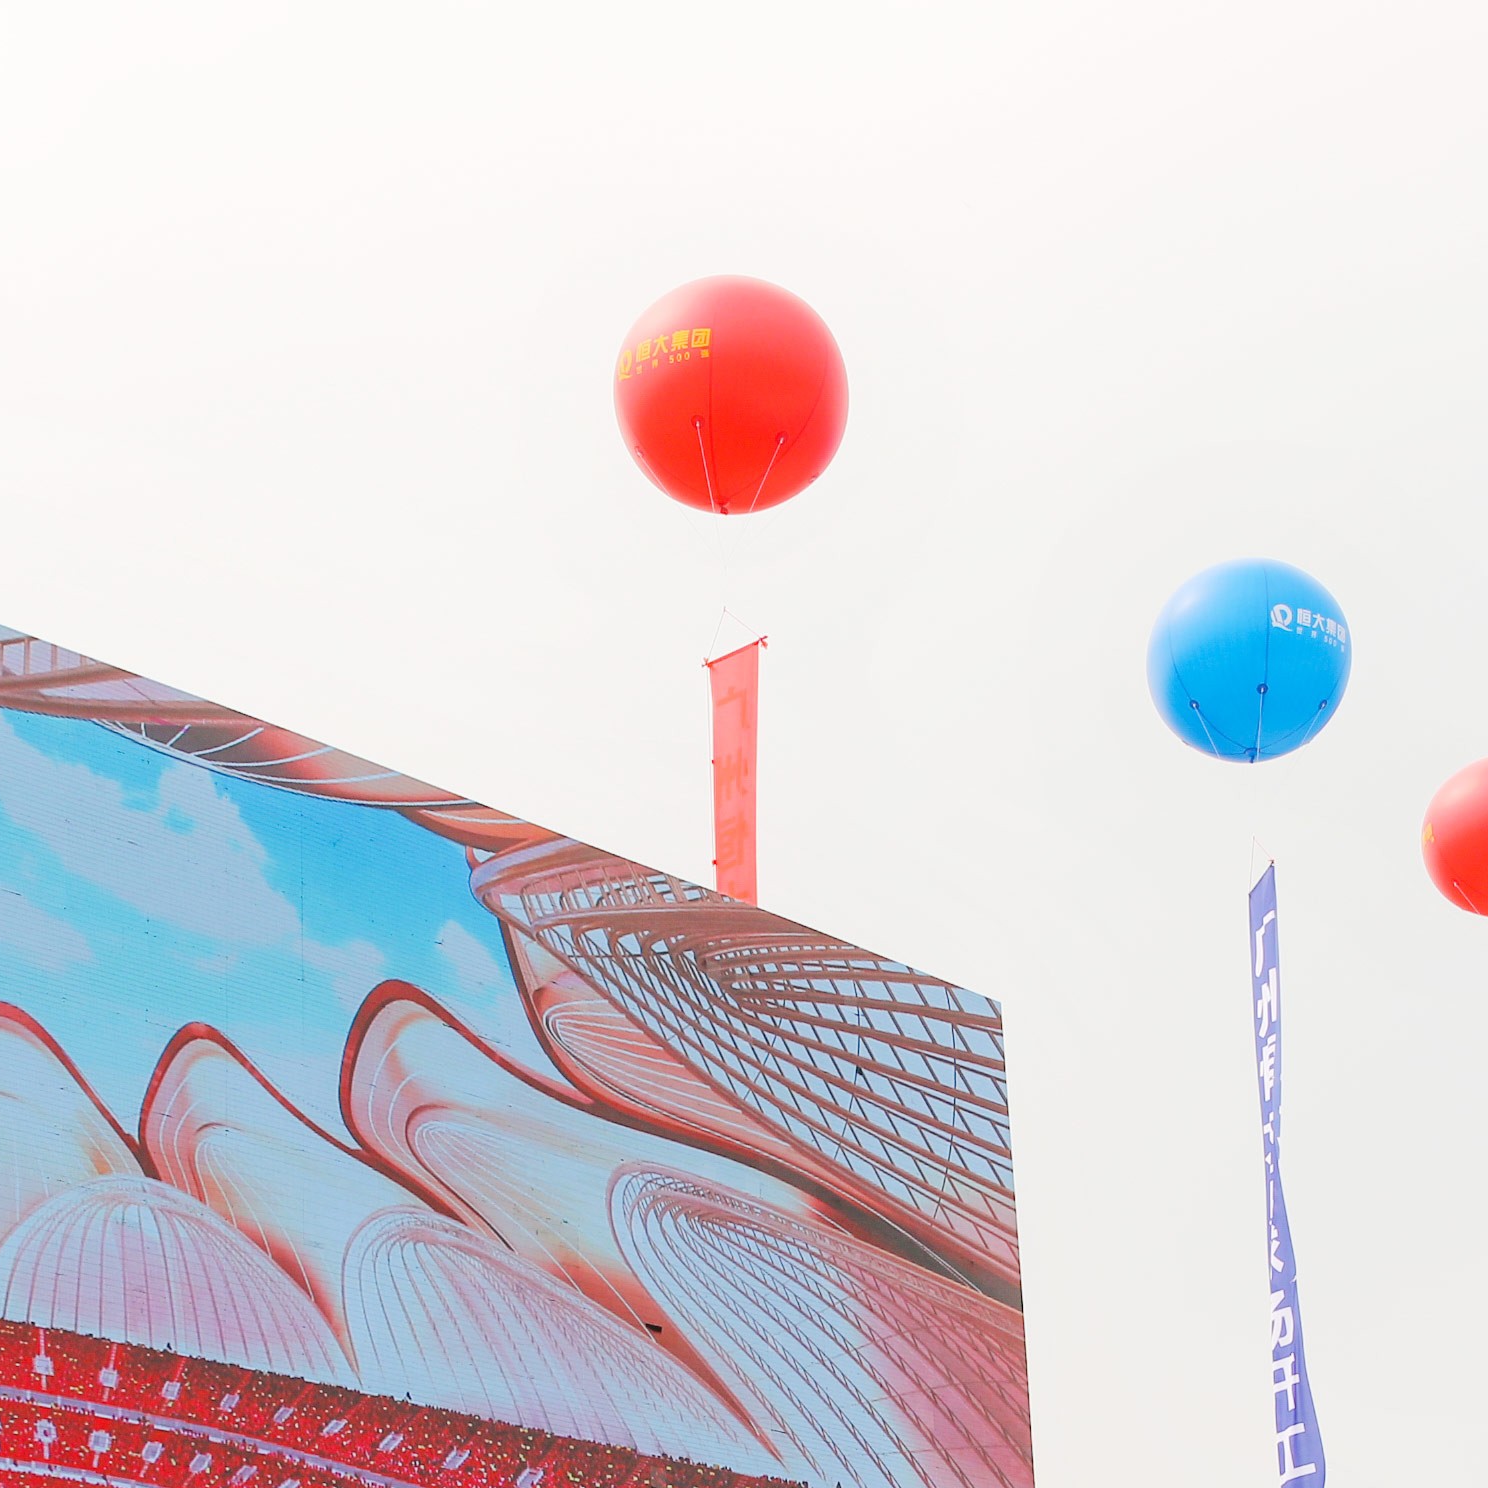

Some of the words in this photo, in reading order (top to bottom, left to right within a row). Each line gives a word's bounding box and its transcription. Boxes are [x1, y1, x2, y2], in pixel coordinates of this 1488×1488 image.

[636, 327, 711, 362] 恒大集团
[1297, 608, 1346, 644] 恒大集团
